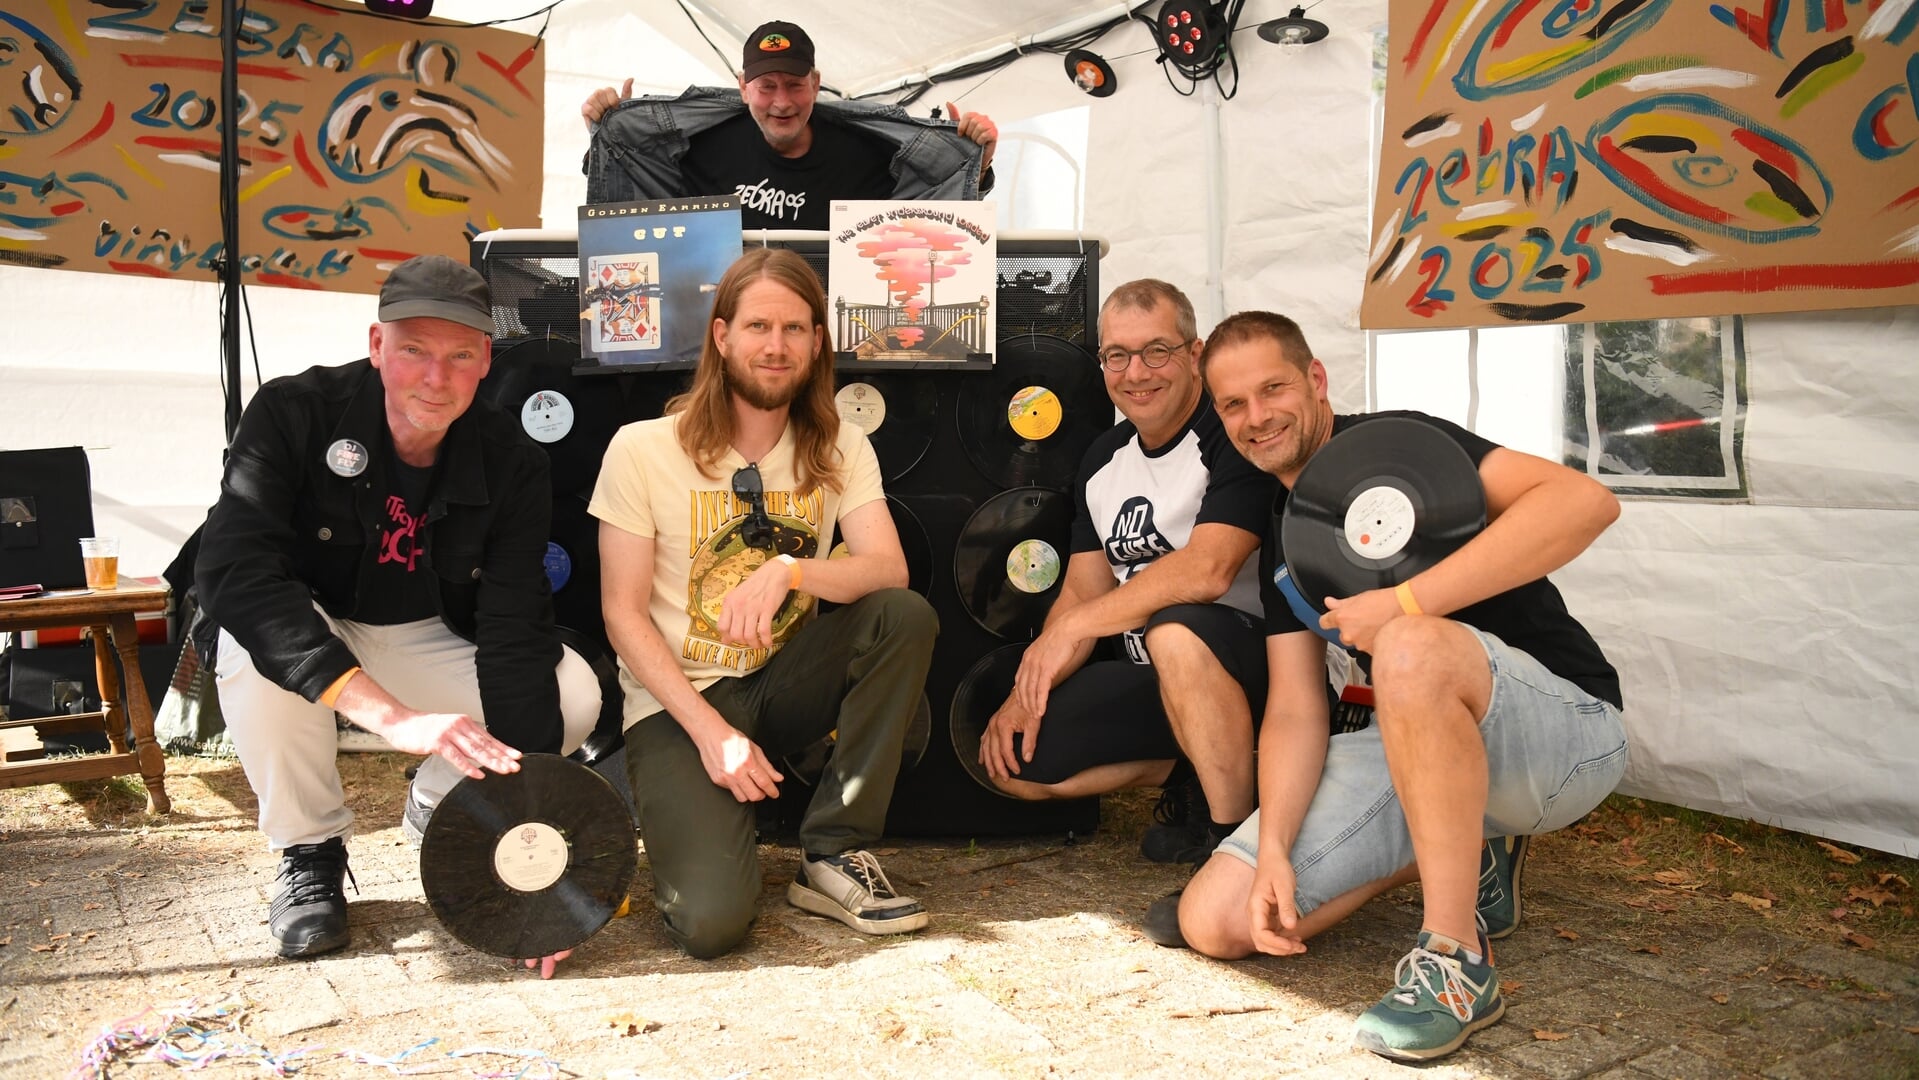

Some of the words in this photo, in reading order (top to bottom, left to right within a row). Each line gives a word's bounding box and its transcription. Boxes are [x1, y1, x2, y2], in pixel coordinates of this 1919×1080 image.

[131, 83, 303, 147] 2025
[587, 207, 649, 217] GOLDEN
[633, 226, 686, 240] CUT
[590, 260, 597, 271] J
[1407, 208, 1612, 312] 2025
[344, 442, 357, 452] DJ
[689, 490, 729, 559] LIVE
[763, 491, 792, 517] HE
[1115, 503, 1149, 539] NO
[682, 636, 718, 665] LOVE
[721, 647, 743, 671] BY
[744, 646, 770, 671] THE
